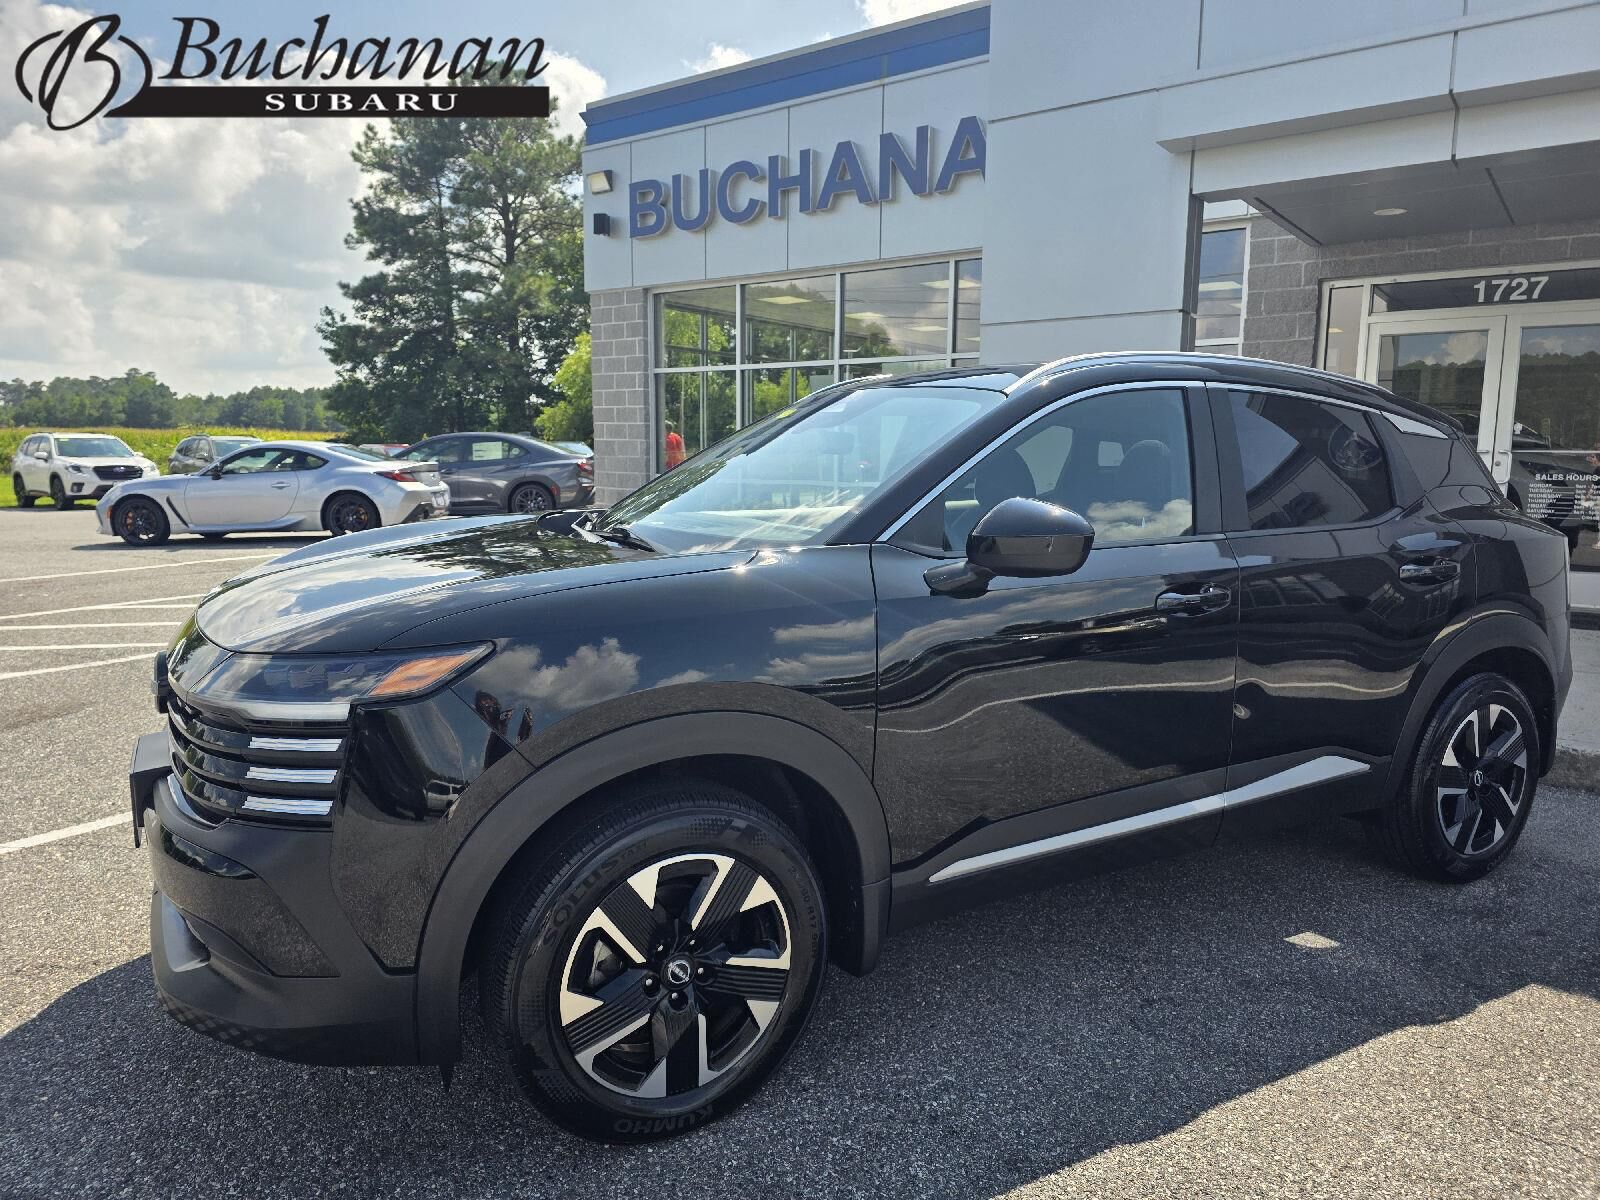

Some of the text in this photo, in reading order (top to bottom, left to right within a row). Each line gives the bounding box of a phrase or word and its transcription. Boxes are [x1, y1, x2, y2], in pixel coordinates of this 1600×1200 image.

[629, 115, 986, 240] BUCHANA
[1474, 275, 1550, 303] 1727
[1535, 473, 1599, 482] SALES HOURS
